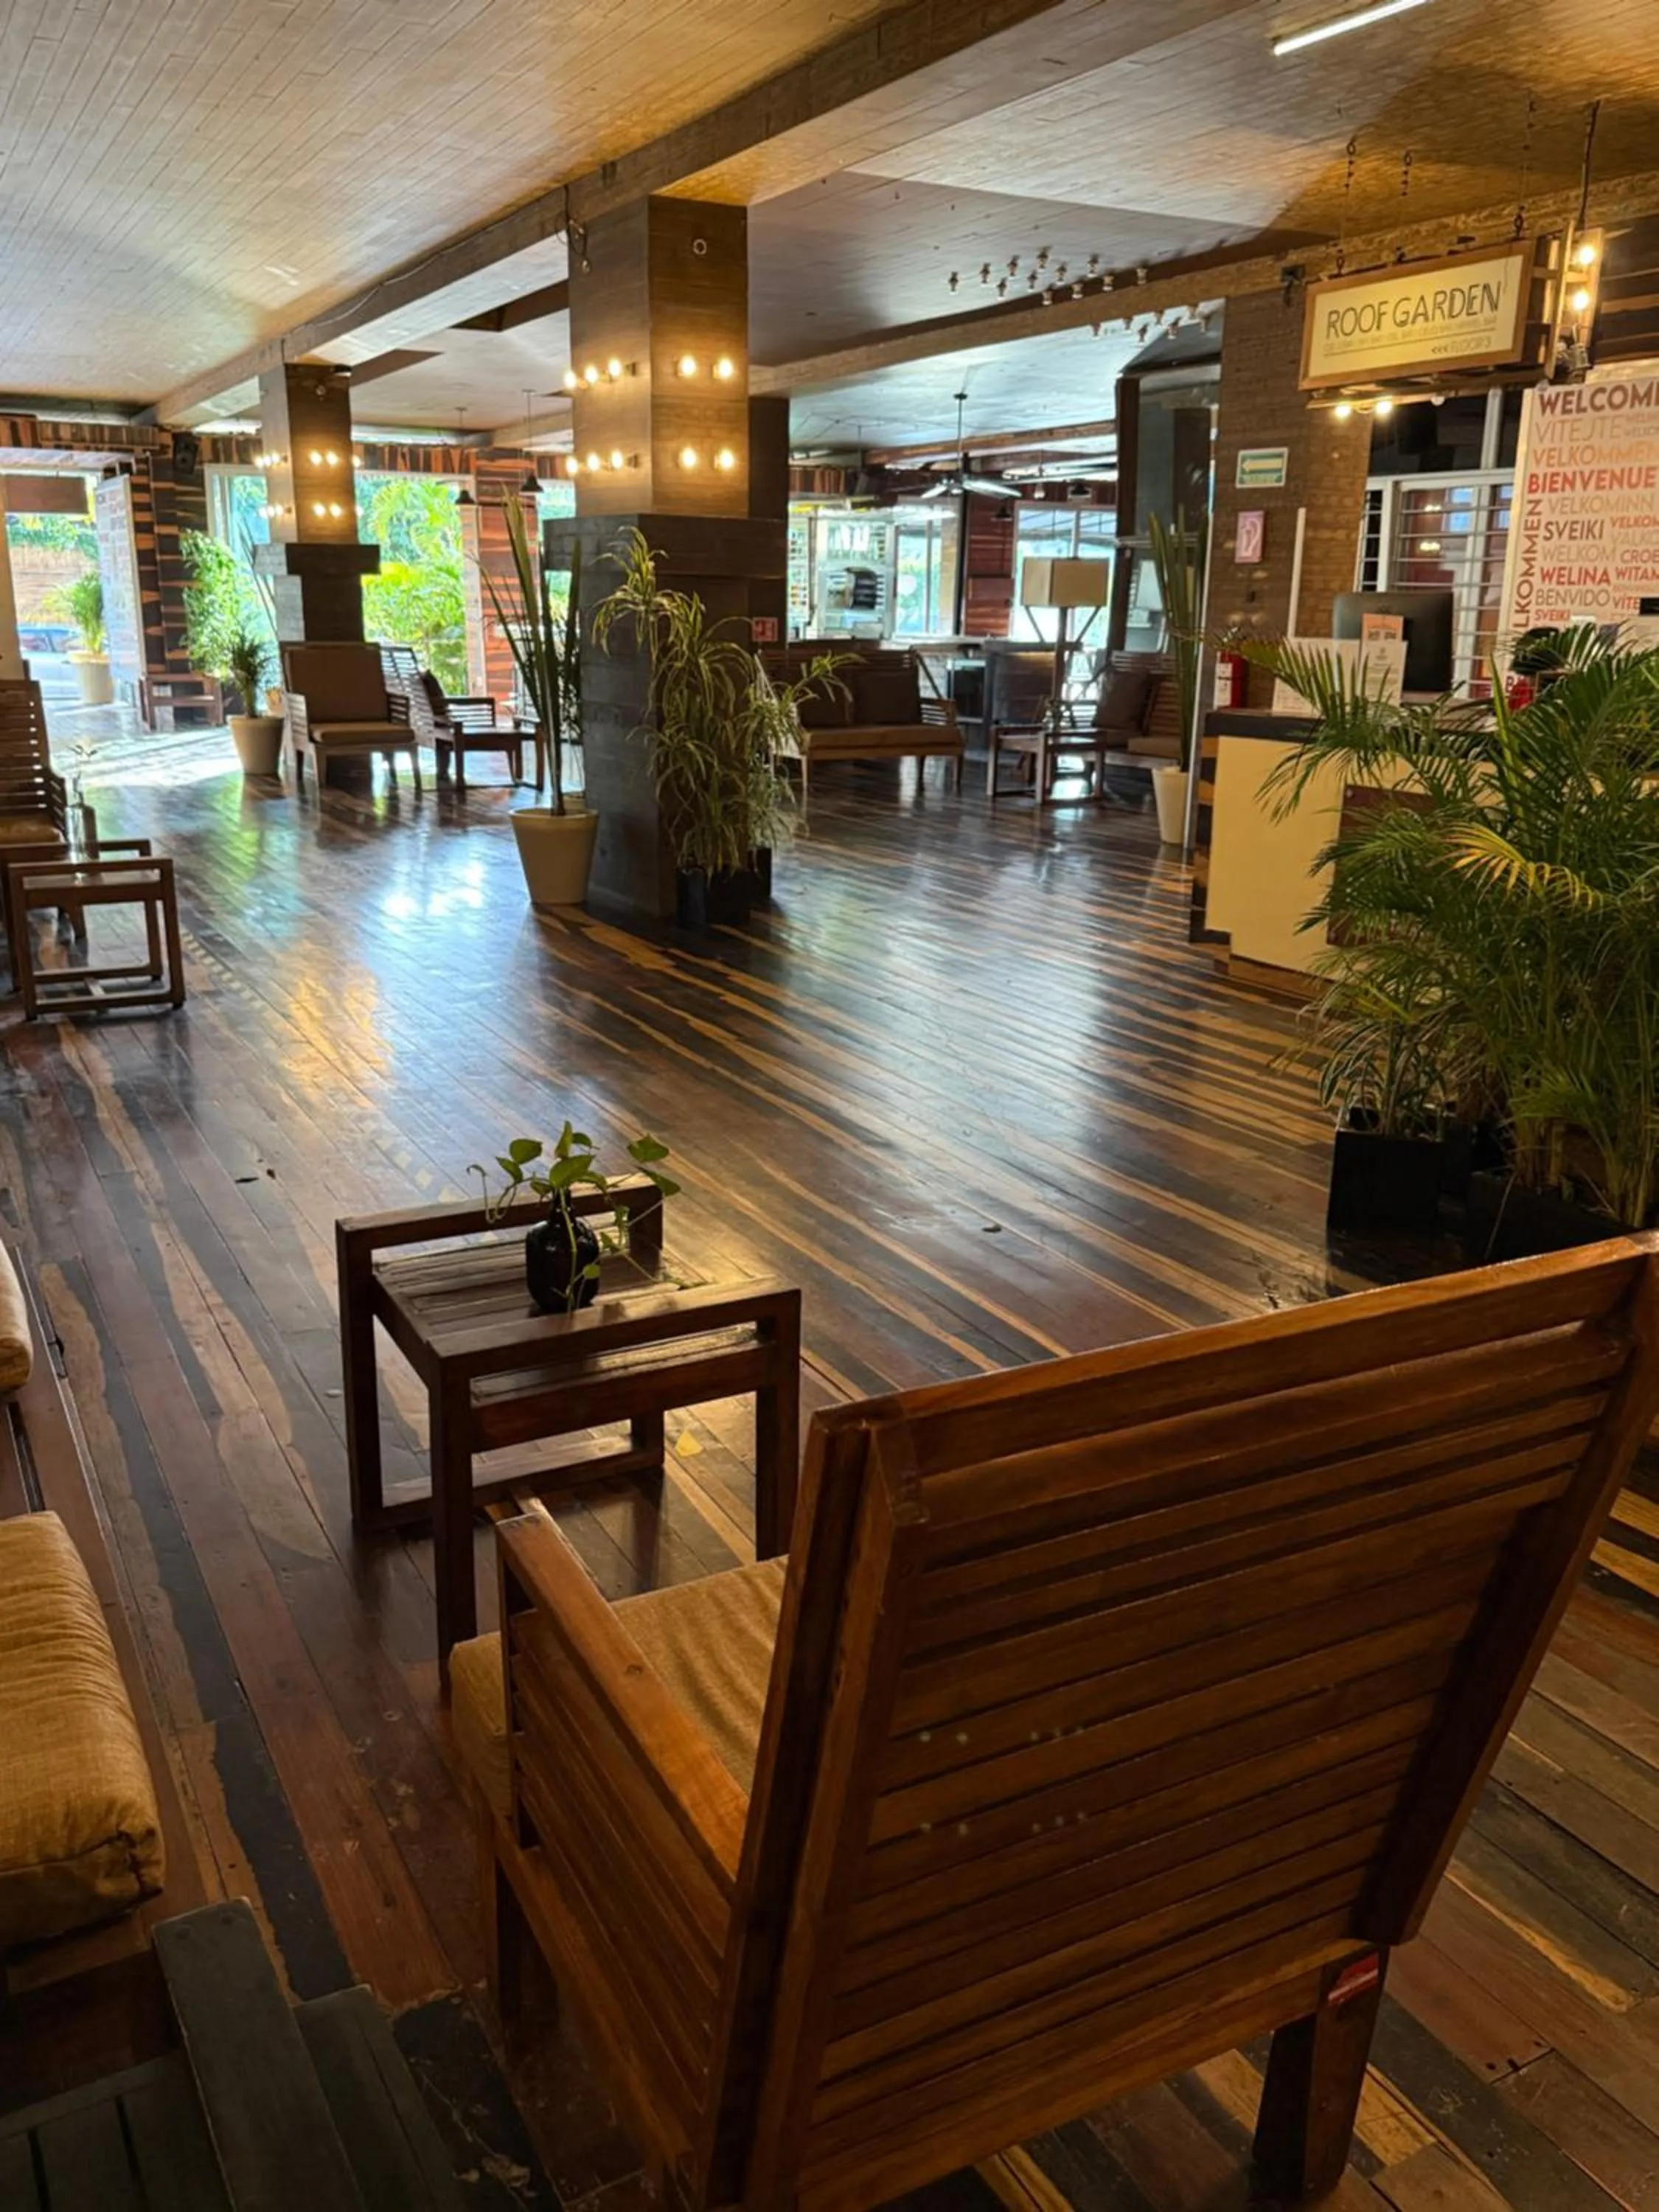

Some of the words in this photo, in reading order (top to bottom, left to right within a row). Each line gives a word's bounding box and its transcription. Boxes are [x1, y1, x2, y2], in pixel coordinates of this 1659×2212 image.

[1326, 300, 1389, 340] ROOF
[1392, 280, 1502, 328] GARDEN
[1535, 416, 1622, 442] VITEJTE
[1527, 466, 1657, 494] BIENVENUE
[1548, 495, 1654, 515] VELKOMINN
[1543, 519, 1605, 541] SVEIKI
[1513, 498, 1543, 628] LKOMMEN
[1541, 544, 1616, 563] WELKOM
[1540, 566, 1611, 586] WELINA
[1534, 588, 1610, 608] BENVIDO
[1534, 608, 1571, 622] SVEIKI
